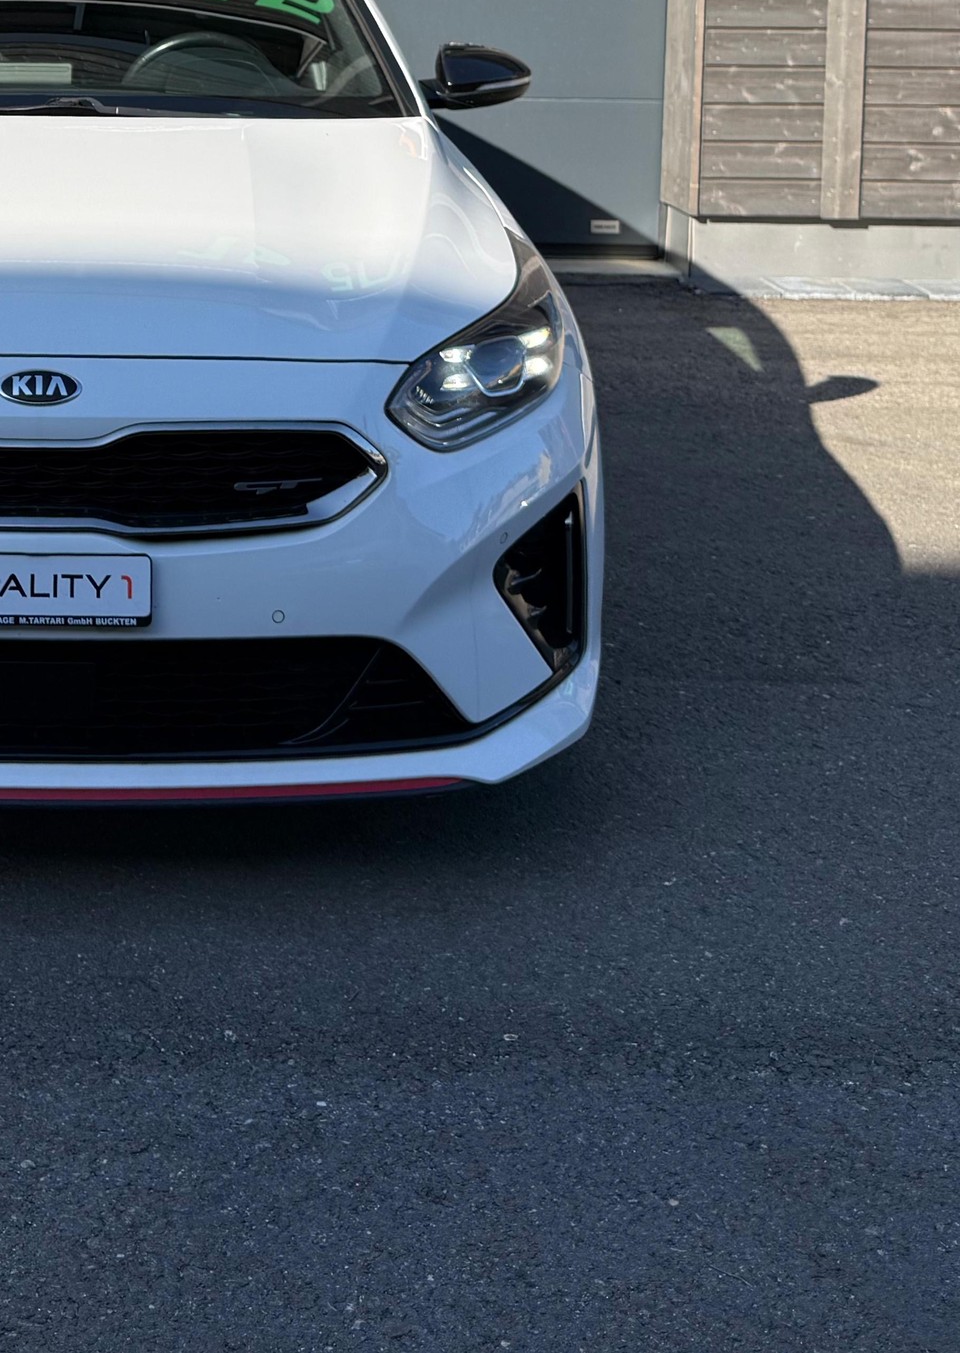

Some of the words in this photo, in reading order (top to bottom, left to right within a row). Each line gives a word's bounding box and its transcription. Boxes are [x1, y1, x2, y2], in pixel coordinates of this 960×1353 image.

[11, 374, 68, 397] KIA
[67, 617, 93, 626] GmbH
[95, 617, 137, 627] BUCKTEN
